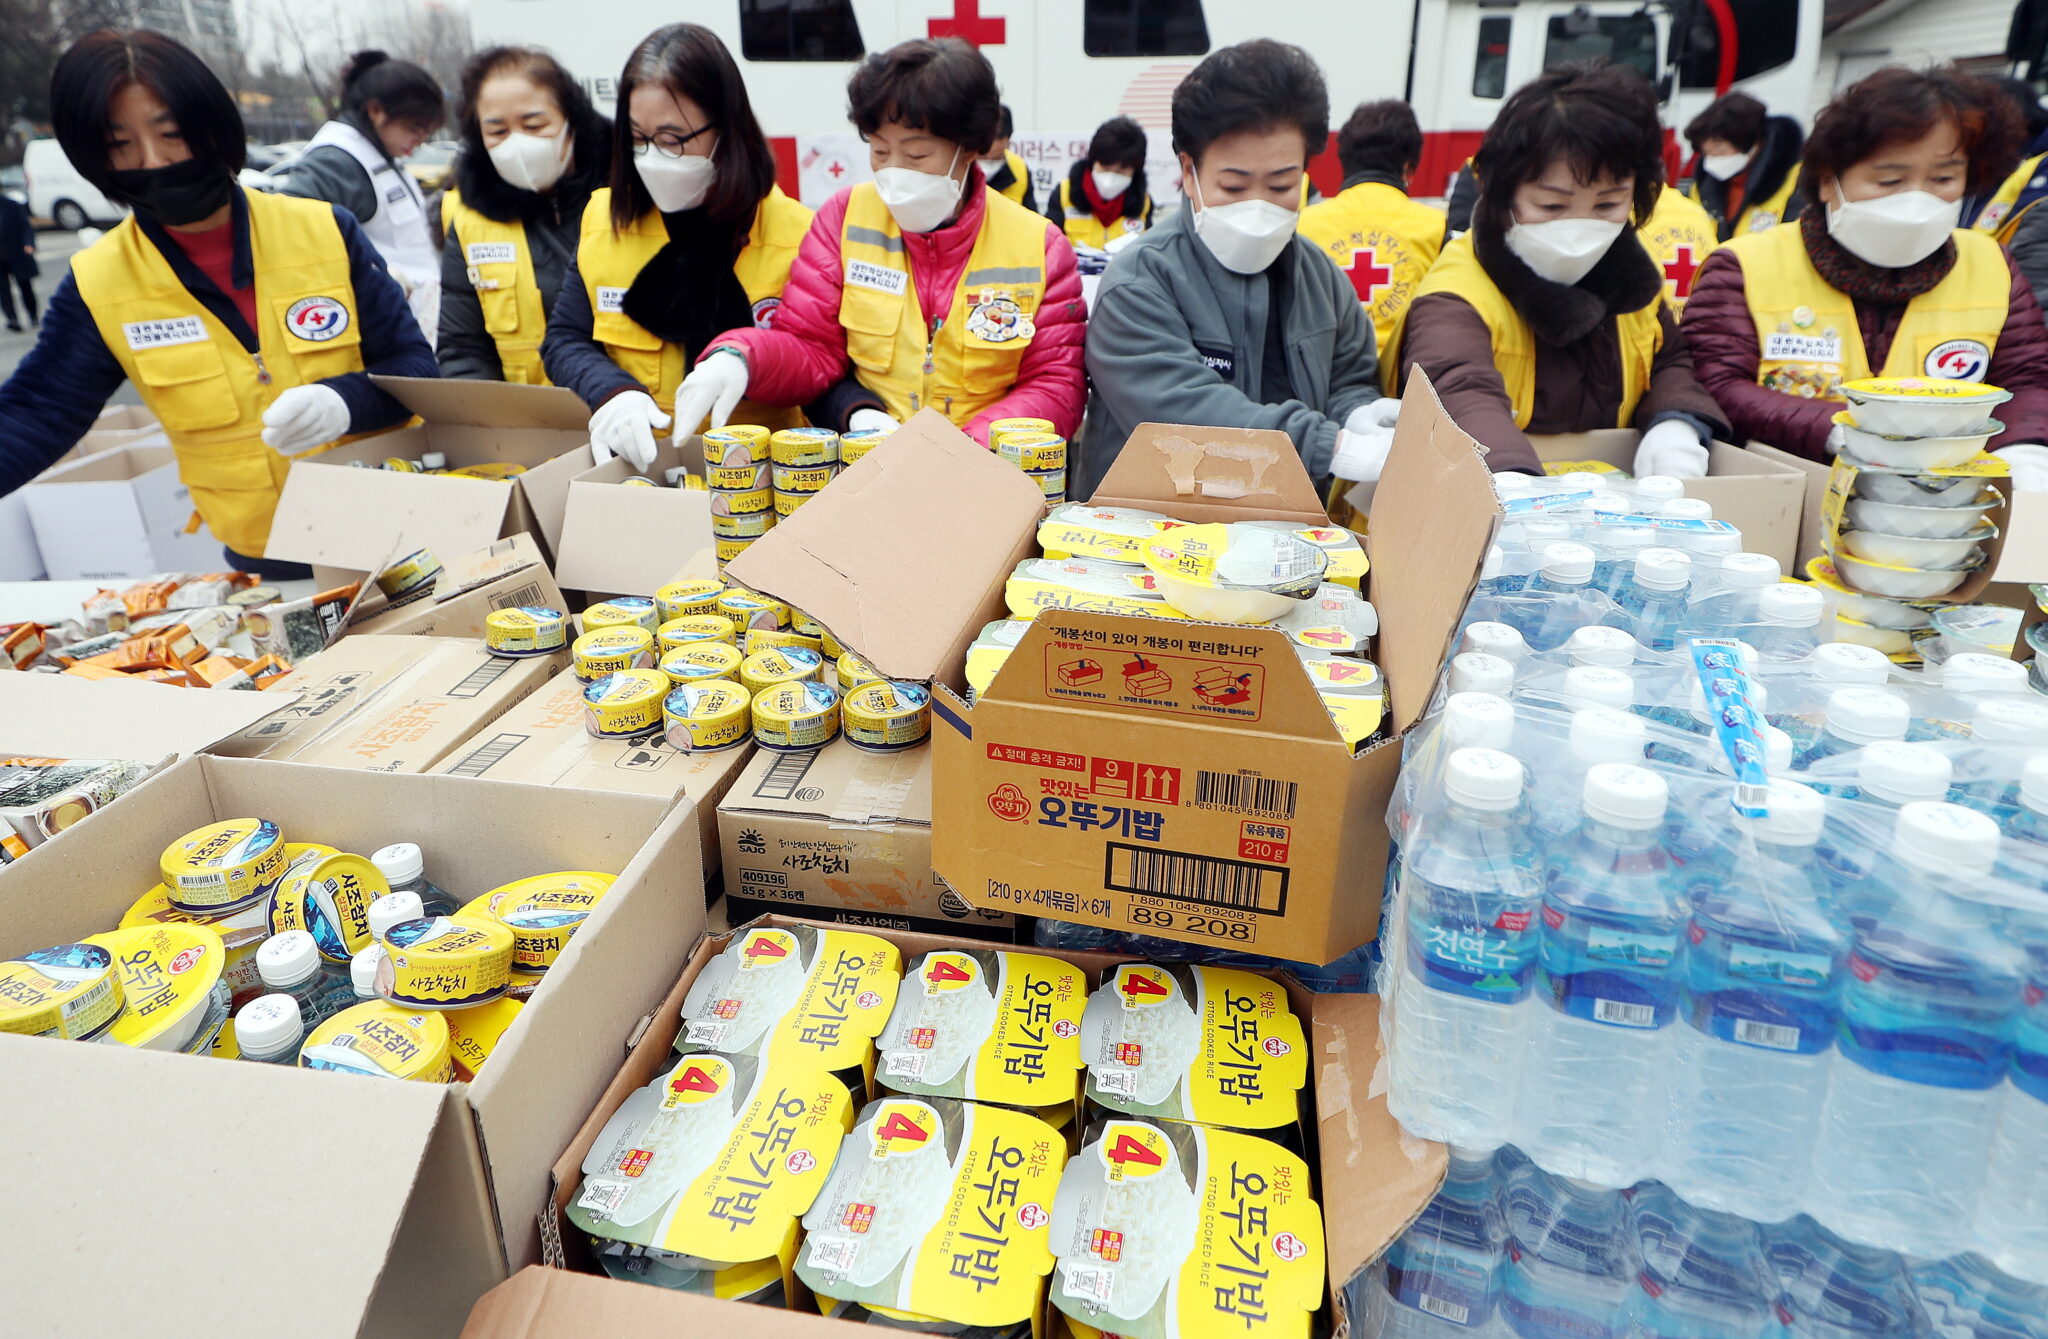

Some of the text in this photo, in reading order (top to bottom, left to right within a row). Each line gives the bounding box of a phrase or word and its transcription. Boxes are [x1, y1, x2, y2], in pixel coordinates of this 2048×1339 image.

[1009, 140, 1062, 162] 이러스
[1330, 230, 1410, 265] 한적십자사
[1378, 280, 1410, 318] CROSS
[1036, 450, 1064, 460] 사조참치
[718, 470, 751, 481] 사조참치
[792, 471, 826, 482] 사조참치
[738, 498, 766, 509] 사조참치
[1056, 530, 1140, 551] 뚜기밥
[1178, 538, 1208, 577] 오뚜기밥
[684, 602, 718, 616] 사조참치
[720, 610, 744, 624] 조참치
[1112, 632, 1138, 647] 있어
[1143, 636, 1183, 650] 개봉이
[1303, 632, 1347, 644] 4
[585, 660, 624, 672] 사조참치
[684, 652, 728, 666] 사조참치
[1326, 662, 1360, 681] 4
[608, 712, 646, 727] 사조참치
[704, 726, 740, 742] 사조참치
[1006, 748, 1026, 761] 절대
[1056, 755, 1081, 769] 금지!
[1105, 760, 1118, 778] 9
[1040, 777, 1090, 800] 맛있는
[996, 800, 1024, 814] 오뚜기
[1198, 803, 1241, 814] 801045
[1247, 809, 1290, 821] 892085
[1038, 796, 1166, 842] 오뚜기밥
[1246, 823, 1286, 840] 묶음제품
[186, 829, 242, 866] 사조참치
[738, 844, 766, 854] SAJO
[1244, 841, 1285, 861] 210 g
[253, 844, 285, 878] 사조참
[782, 852, 850, 875] 사조참치
[742, 870, 786, 886] 409196
[526, 892, 595, 906] 사조참치
[742, 885, 756, 896] 85
[758, 888, 765, 898] g
[780, 890, 805, 902] 36캔
[337, 896, 351, 922] 살코기
[341, 873, 370, 938] 사조참치
[1140, 895, 1164, 908] 880
[1168, 900, 1200, 914] 1045
[1202, 904, 1246, 920] 89208
[1248, 913, 1257, 922] 2
[1132, 907, 1250, 941] 89 208
[150, 928, 173, 956] 맛있는
[426, 932, 488, 953] 사조참치
[514, 937, 560, 952] 조참치
[744, 938, 787, 958] 4
[1426, 924, 1520, 968] 천연수
[518, 952, 545, 963] 살코기
[866, 950, 886, 976] 맛있는
[927, 962, 971, 982] 4
[119, 950, 180, 1018] 오뚜기밥
[409, 974, 467, 994] 사조참치
[792, 960, 826, 1029] OTTOGI COOKED RICE
[1056, 975, 1074, 1002] 맛있는
[1122, 974, 1168, 996] 4
[800, 949, 866, 1051] 오뚜기밥
[1260, 991, 1276, 1019] 맛있는
[994, 984, 1014, 1060] OTTOGI COOKED RICE
[1004, 973, 1054, 1084] 오뚜기밥
[356, 1019, 420, 1063] 사조참치
[358, 1040, 386, 1059] 살코기
[1206, 1028, 1214, 1058] COOKED
[1218, 988, 1264, 1106] 오뚜기밥
[456, 1038, 489, 1068] 오뚜기
[671, 1066, 720, 1094] 4
[1206, 1061, 1214, 1080] RICE
[664, 1092, 680, 1109] 개입
[804, 1092, 834, 1127] 맛있는
[876, 1112, 928, 1142] 4
[704, 1101, 762, 1197] OTTOGI COOKED RICE
[708, 1088, 806, 1232] 오뚜기밥
[874, 1140, 888, 1158] 개입
[1026, 1140, 1050, 1178] 맛있는
[1108, 1134, 1162, 1166] 4
[1110, 1164, 1124, 1182] 개입
[1274, 1165, 1292, 1206] 맛있는
[940, 1150, 978, 1254] OTTOGI COOKED RICE
[949, 1136, 1025, 1292] 오뚜기밥
[1200, 1176, 1218, 1288] OTTOGI COOKED RICE
[1214, 1160, 1269, 1330] 오뚜기밥
